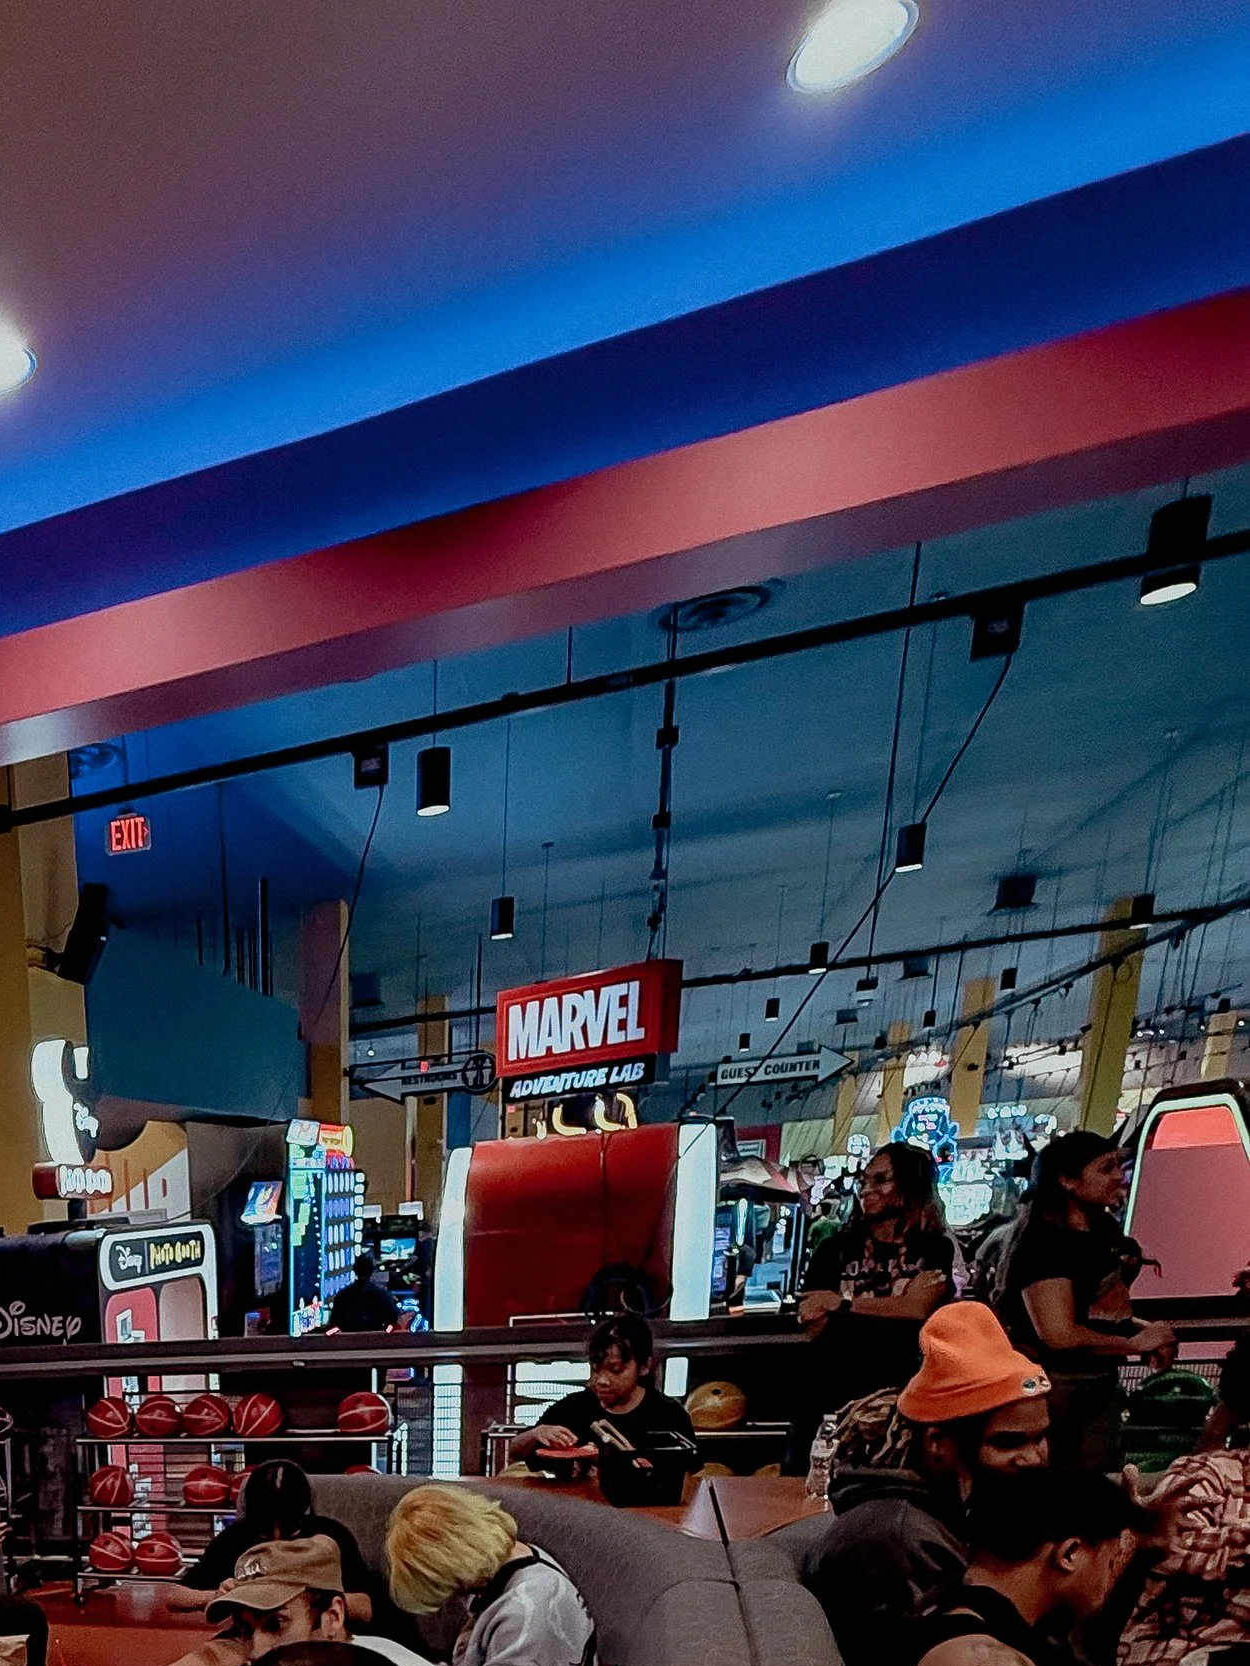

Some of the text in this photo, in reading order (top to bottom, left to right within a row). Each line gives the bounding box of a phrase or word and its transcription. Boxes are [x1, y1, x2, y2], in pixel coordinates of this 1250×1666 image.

[110, 816, 145, 851] EXIT
[507, 980, 646, 1062] MARVEL
[509, 1062, 646, 1099] ADVENTURE LAB
[763, 1059, 820, 1076] COUNTER
